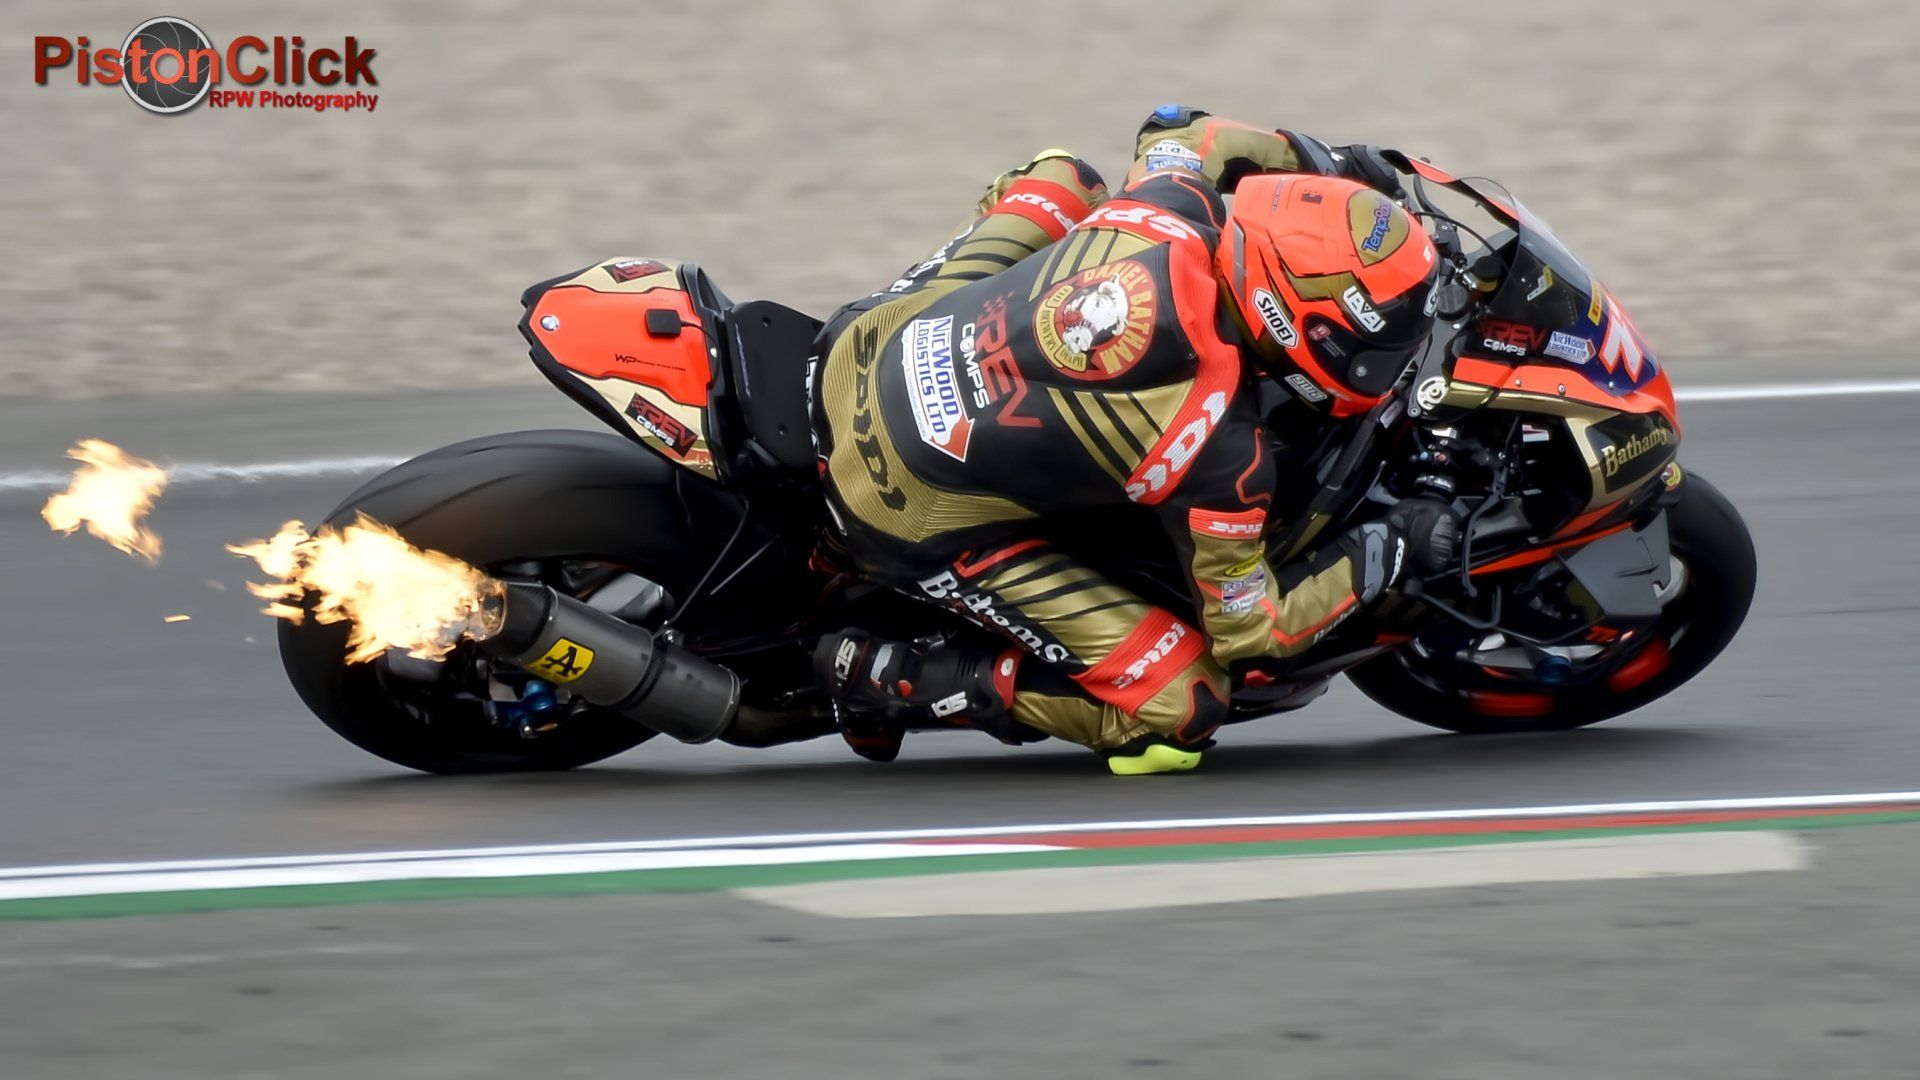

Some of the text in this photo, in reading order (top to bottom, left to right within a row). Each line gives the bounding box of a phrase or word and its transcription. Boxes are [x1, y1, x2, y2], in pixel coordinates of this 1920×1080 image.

[1099, 290, 1152, 374] BATHAM
[1257, 296, 1294, 342] SHOEI
[1483, 338, 1527, 357] COMPS
[1484, 320, 1549, 351] REV
[916, 321, 947, 434] LOGISTICS LTD
[960, 322, 990, 409] COMPS
[975, 303, 1043, 428] REV
[636, 414, 676, 447] COMPS
[637, 396, 699, 447] REV
[853, 325, 907, 512] SPIDI
[1111, 622, 1185, 690] SPIDI
